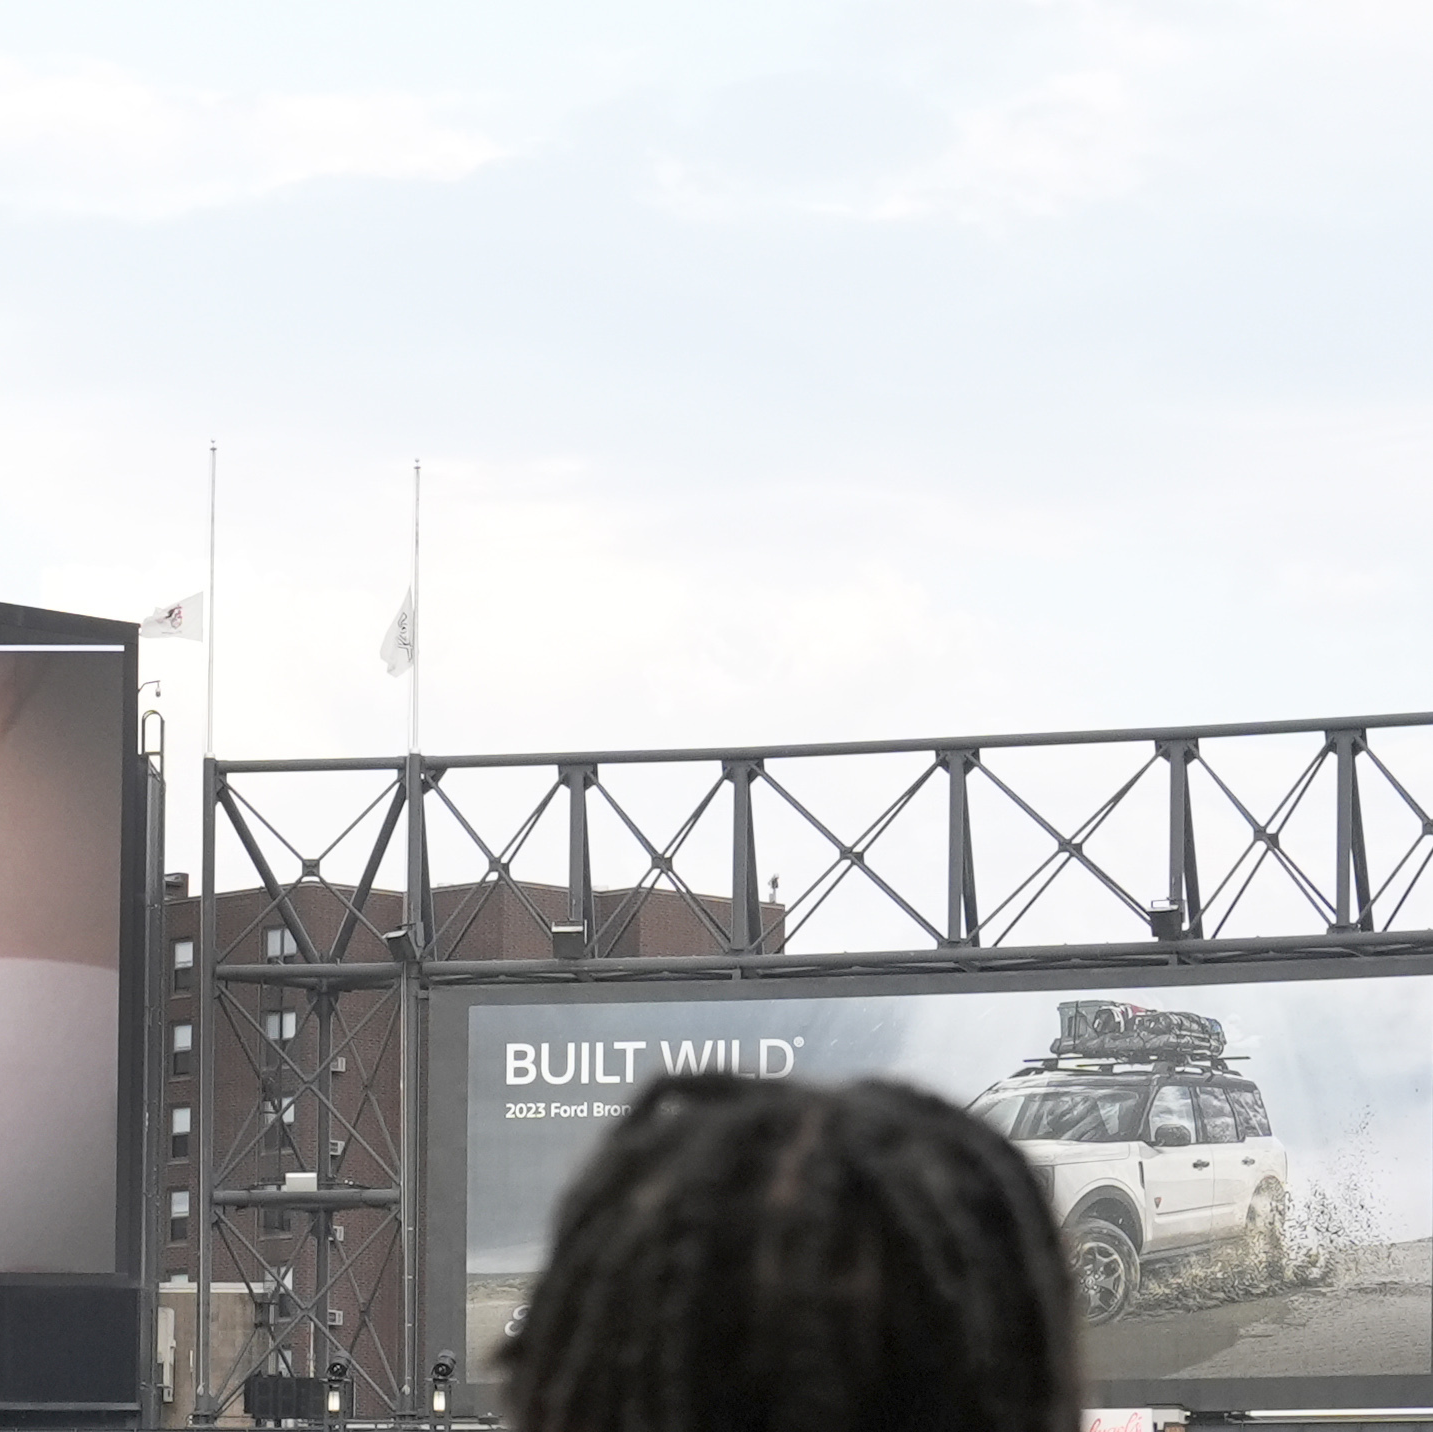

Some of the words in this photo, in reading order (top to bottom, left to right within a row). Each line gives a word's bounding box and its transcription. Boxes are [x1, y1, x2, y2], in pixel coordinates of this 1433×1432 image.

[505, 1041, 647, 1085] BUILT
[505, 1103, 546, 1119] 2023
[551, 1102, 588, 1118] Ford
